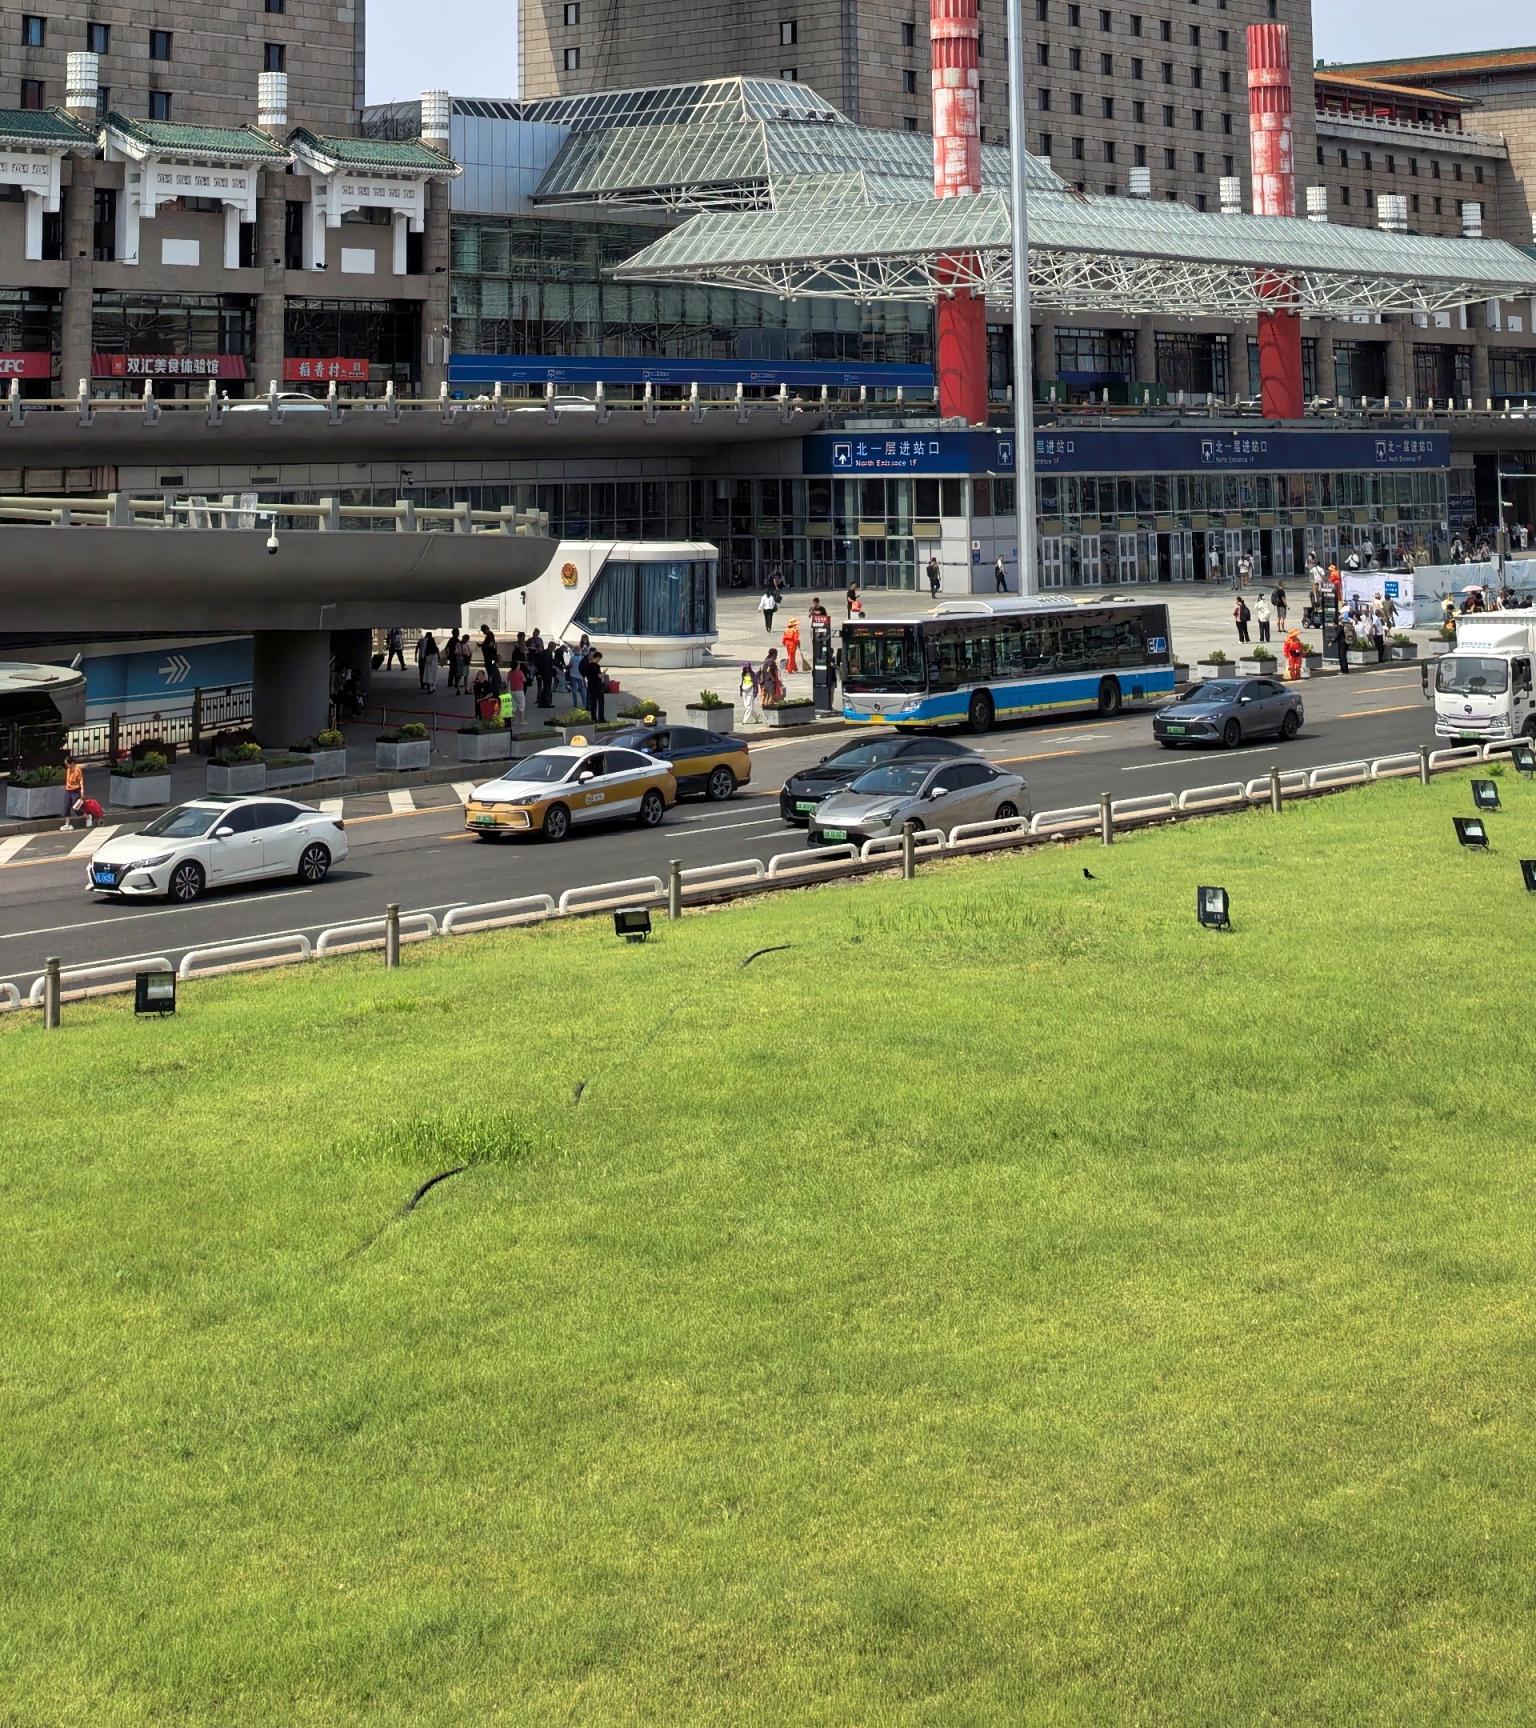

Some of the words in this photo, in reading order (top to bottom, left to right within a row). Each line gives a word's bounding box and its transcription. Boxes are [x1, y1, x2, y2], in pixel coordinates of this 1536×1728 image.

[127, 357, 220, 375] 双汇美食体验馆
[299, 361, 340, 378] 稻香村
[855, 440, 940, 456] 北一层进站口
[1035, 439, 1075, 454] 层进站口
